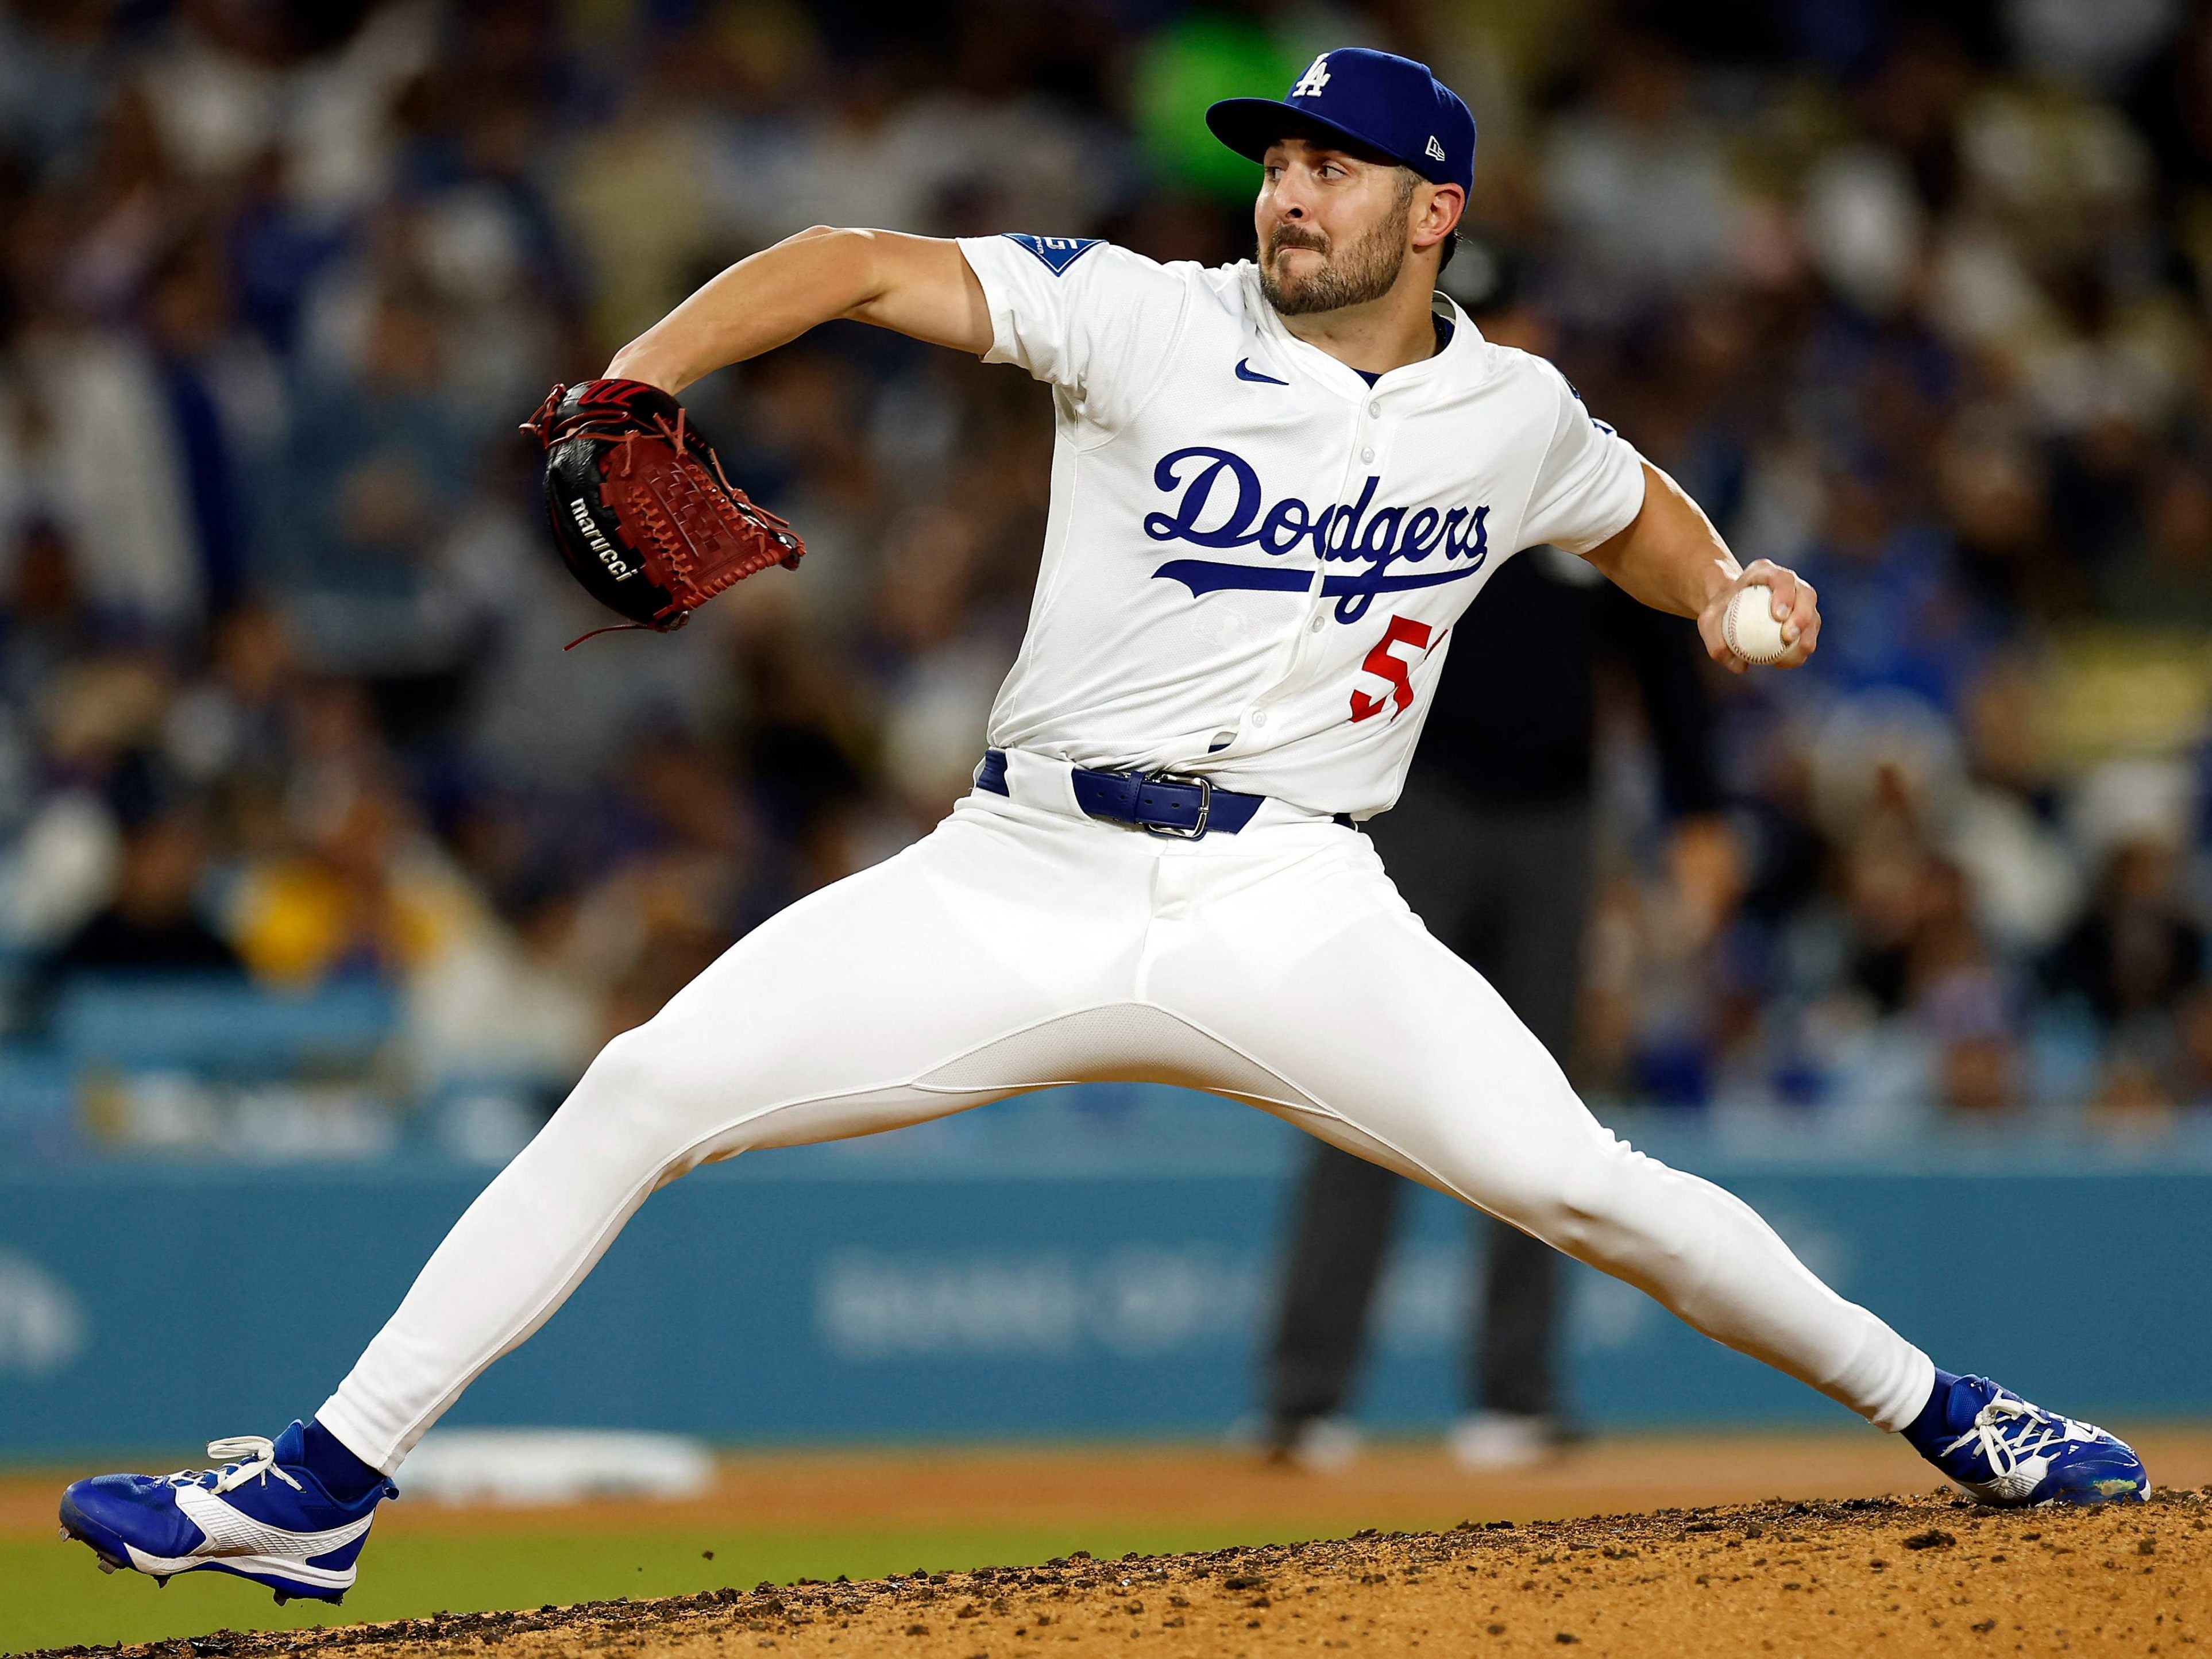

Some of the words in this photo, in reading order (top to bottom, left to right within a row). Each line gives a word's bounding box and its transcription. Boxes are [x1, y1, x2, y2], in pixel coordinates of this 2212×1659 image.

[1292, 52, 1331, 97] LA
[570, 497, 639, 582] marucci
[1143, 446, 1490, 624] Dodgers
[1348, 615, 1448, 723] 5
